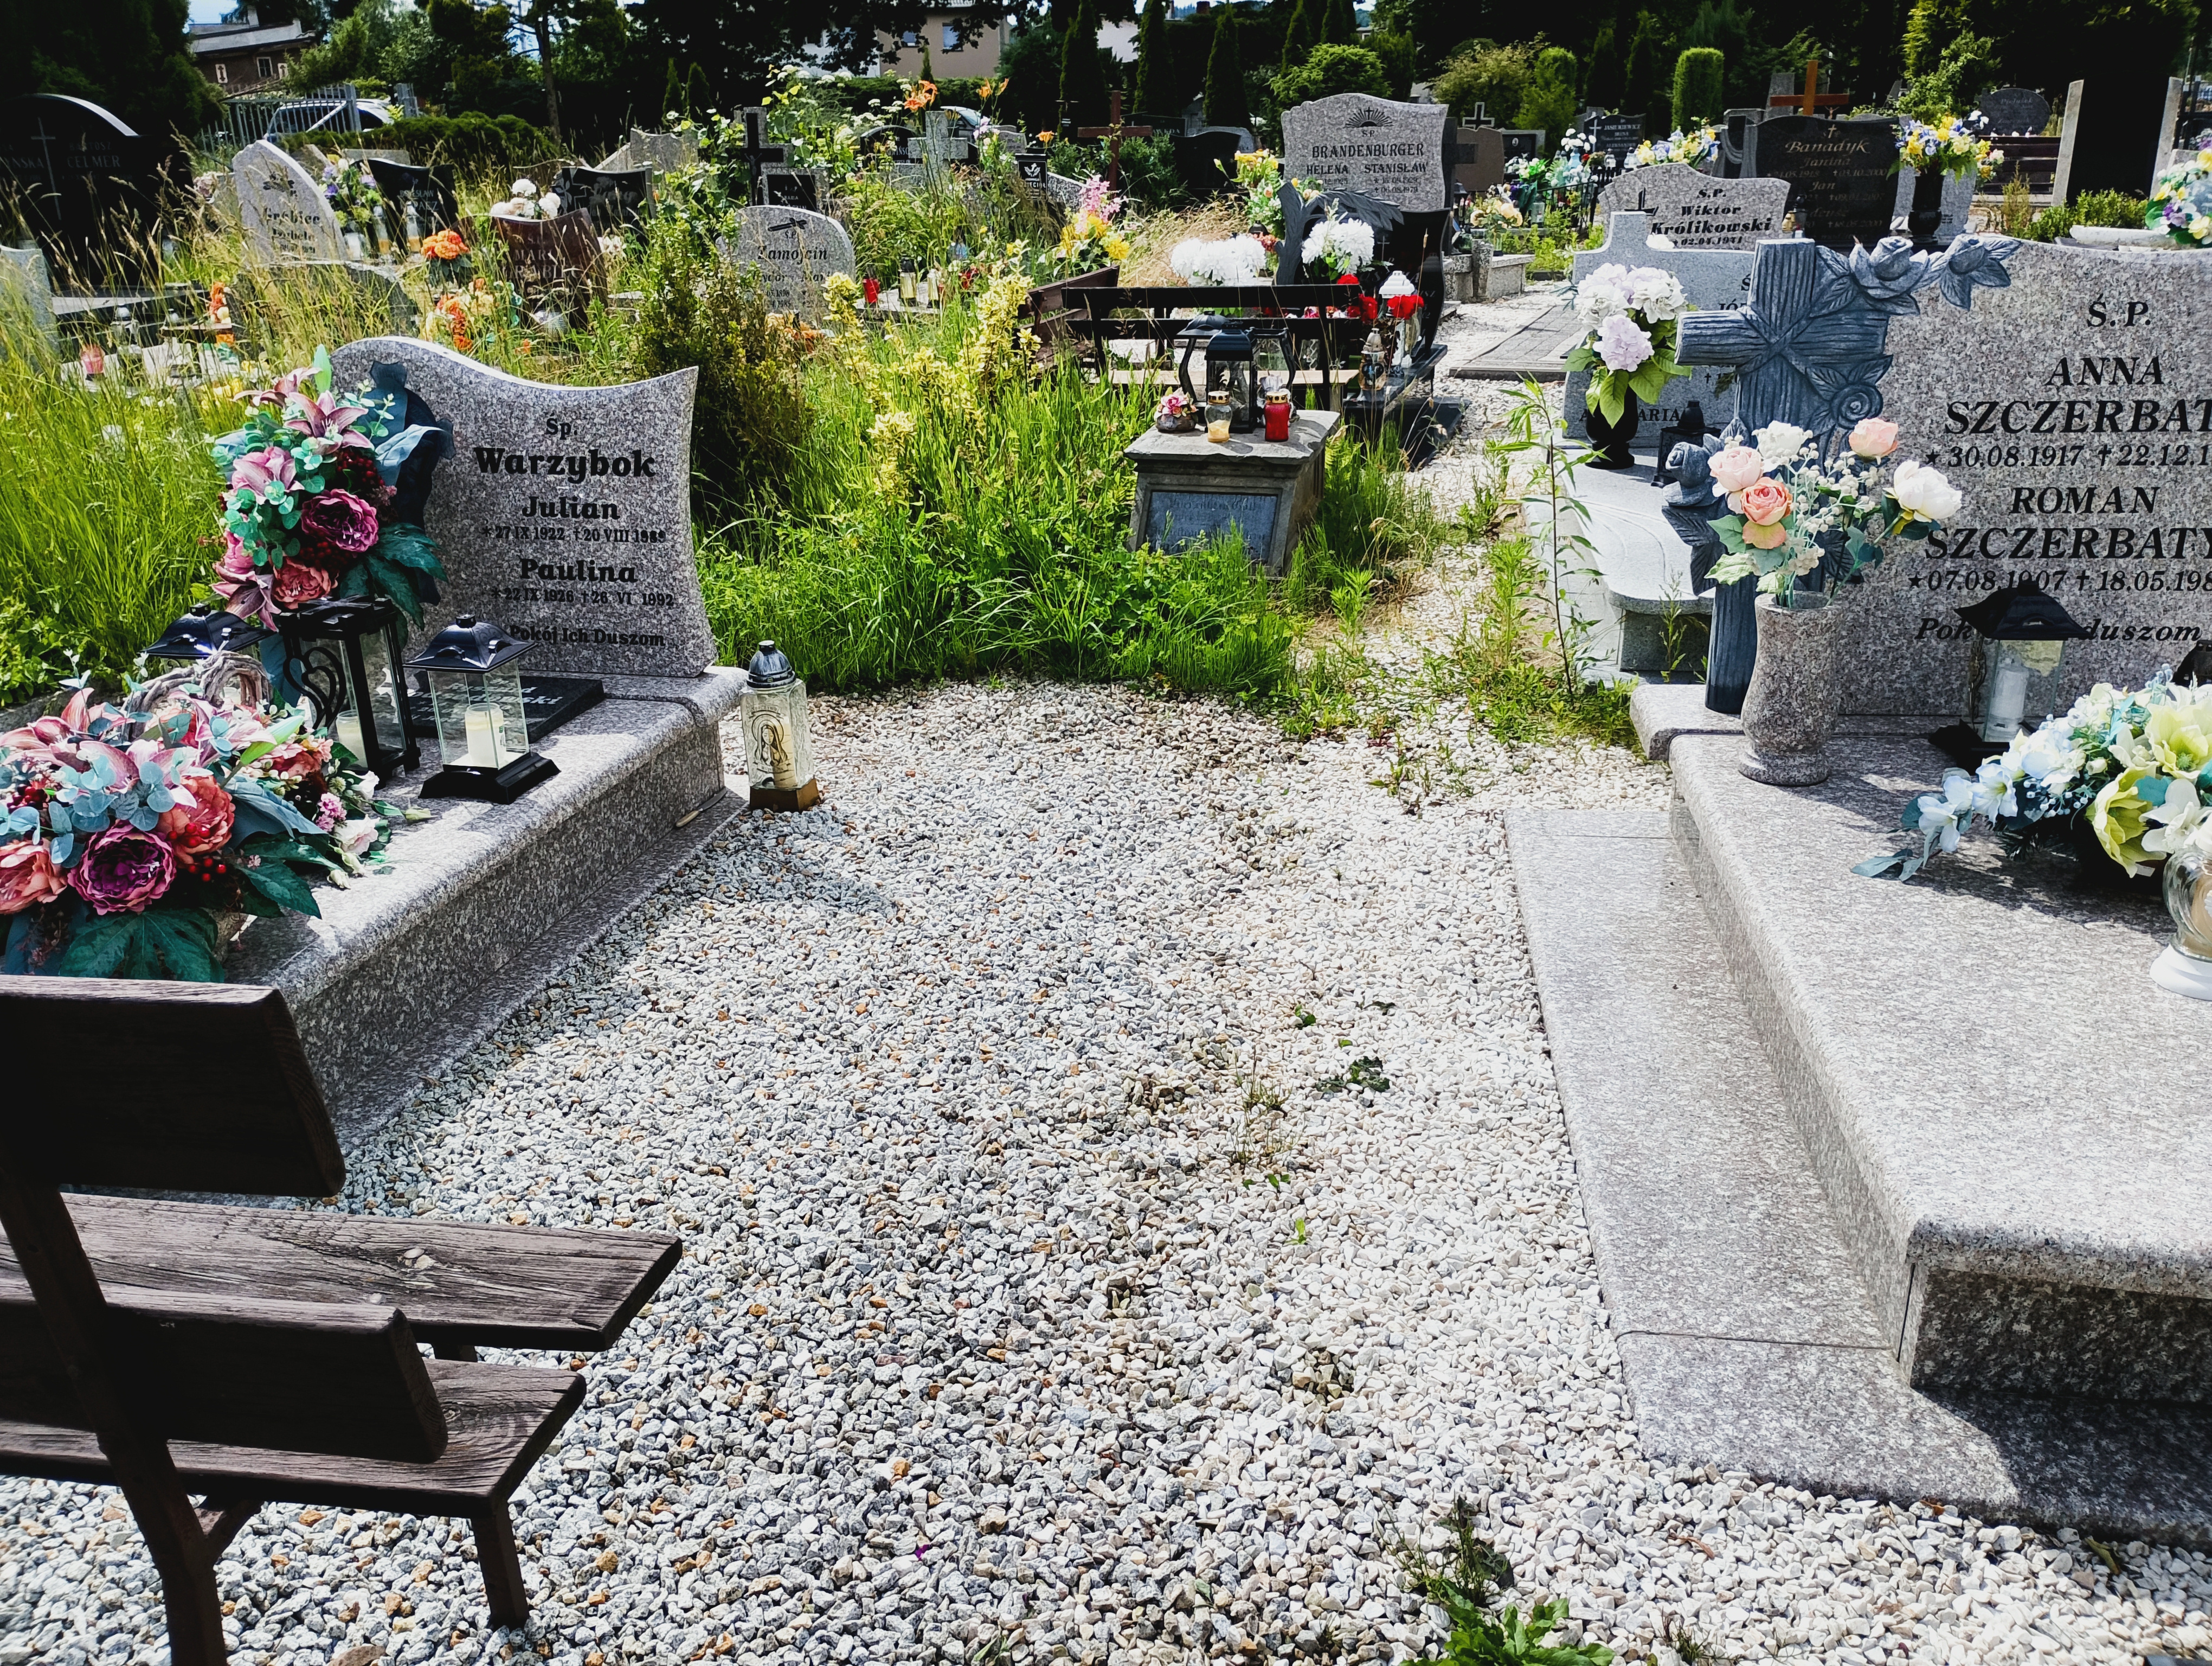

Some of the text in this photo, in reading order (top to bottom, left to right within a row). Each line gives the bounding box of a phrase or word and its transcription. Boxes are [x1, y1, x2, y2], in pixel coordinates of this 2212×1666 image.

[1312, 144, 1424, 158] BRANDENBURGER
[1785, 138, 1870, 156] Banadyk
[67, 155, 121, 168] CELMER
[1306, 164, 1349, 175] HELENA
[1800, 157, 1851, 168] Janina
[1809, 181, 1836, 191] Jan
[1682, 205, 1741, 216] Wiktor
[1651, 218, 1771, 234] Królikowski
[2044, 355, 2164, 386] ANNA
[1947, 445, 2084, 467] 30.08.1917
[473, 447, 657, 484] Warzybok
[522, 496, 620, 520] Julian
[2008, 487, 2160, 514] ROMAN
[495, 526, 510, 540] 27
[515, 526, 530, 540] IX
[533, 526, 565, 541] 1922
[583, 528, 600, 542] 20
[603, 529, 629, 542] VIII
[519, 558, 638, 583] Paulina
[504, 587, 674, 606] 22 IX 1926 26 VI 1992
[509, 625, 666, 646] Pokój Ich Duszom
[2078, 618, 2201, 640] duszom
